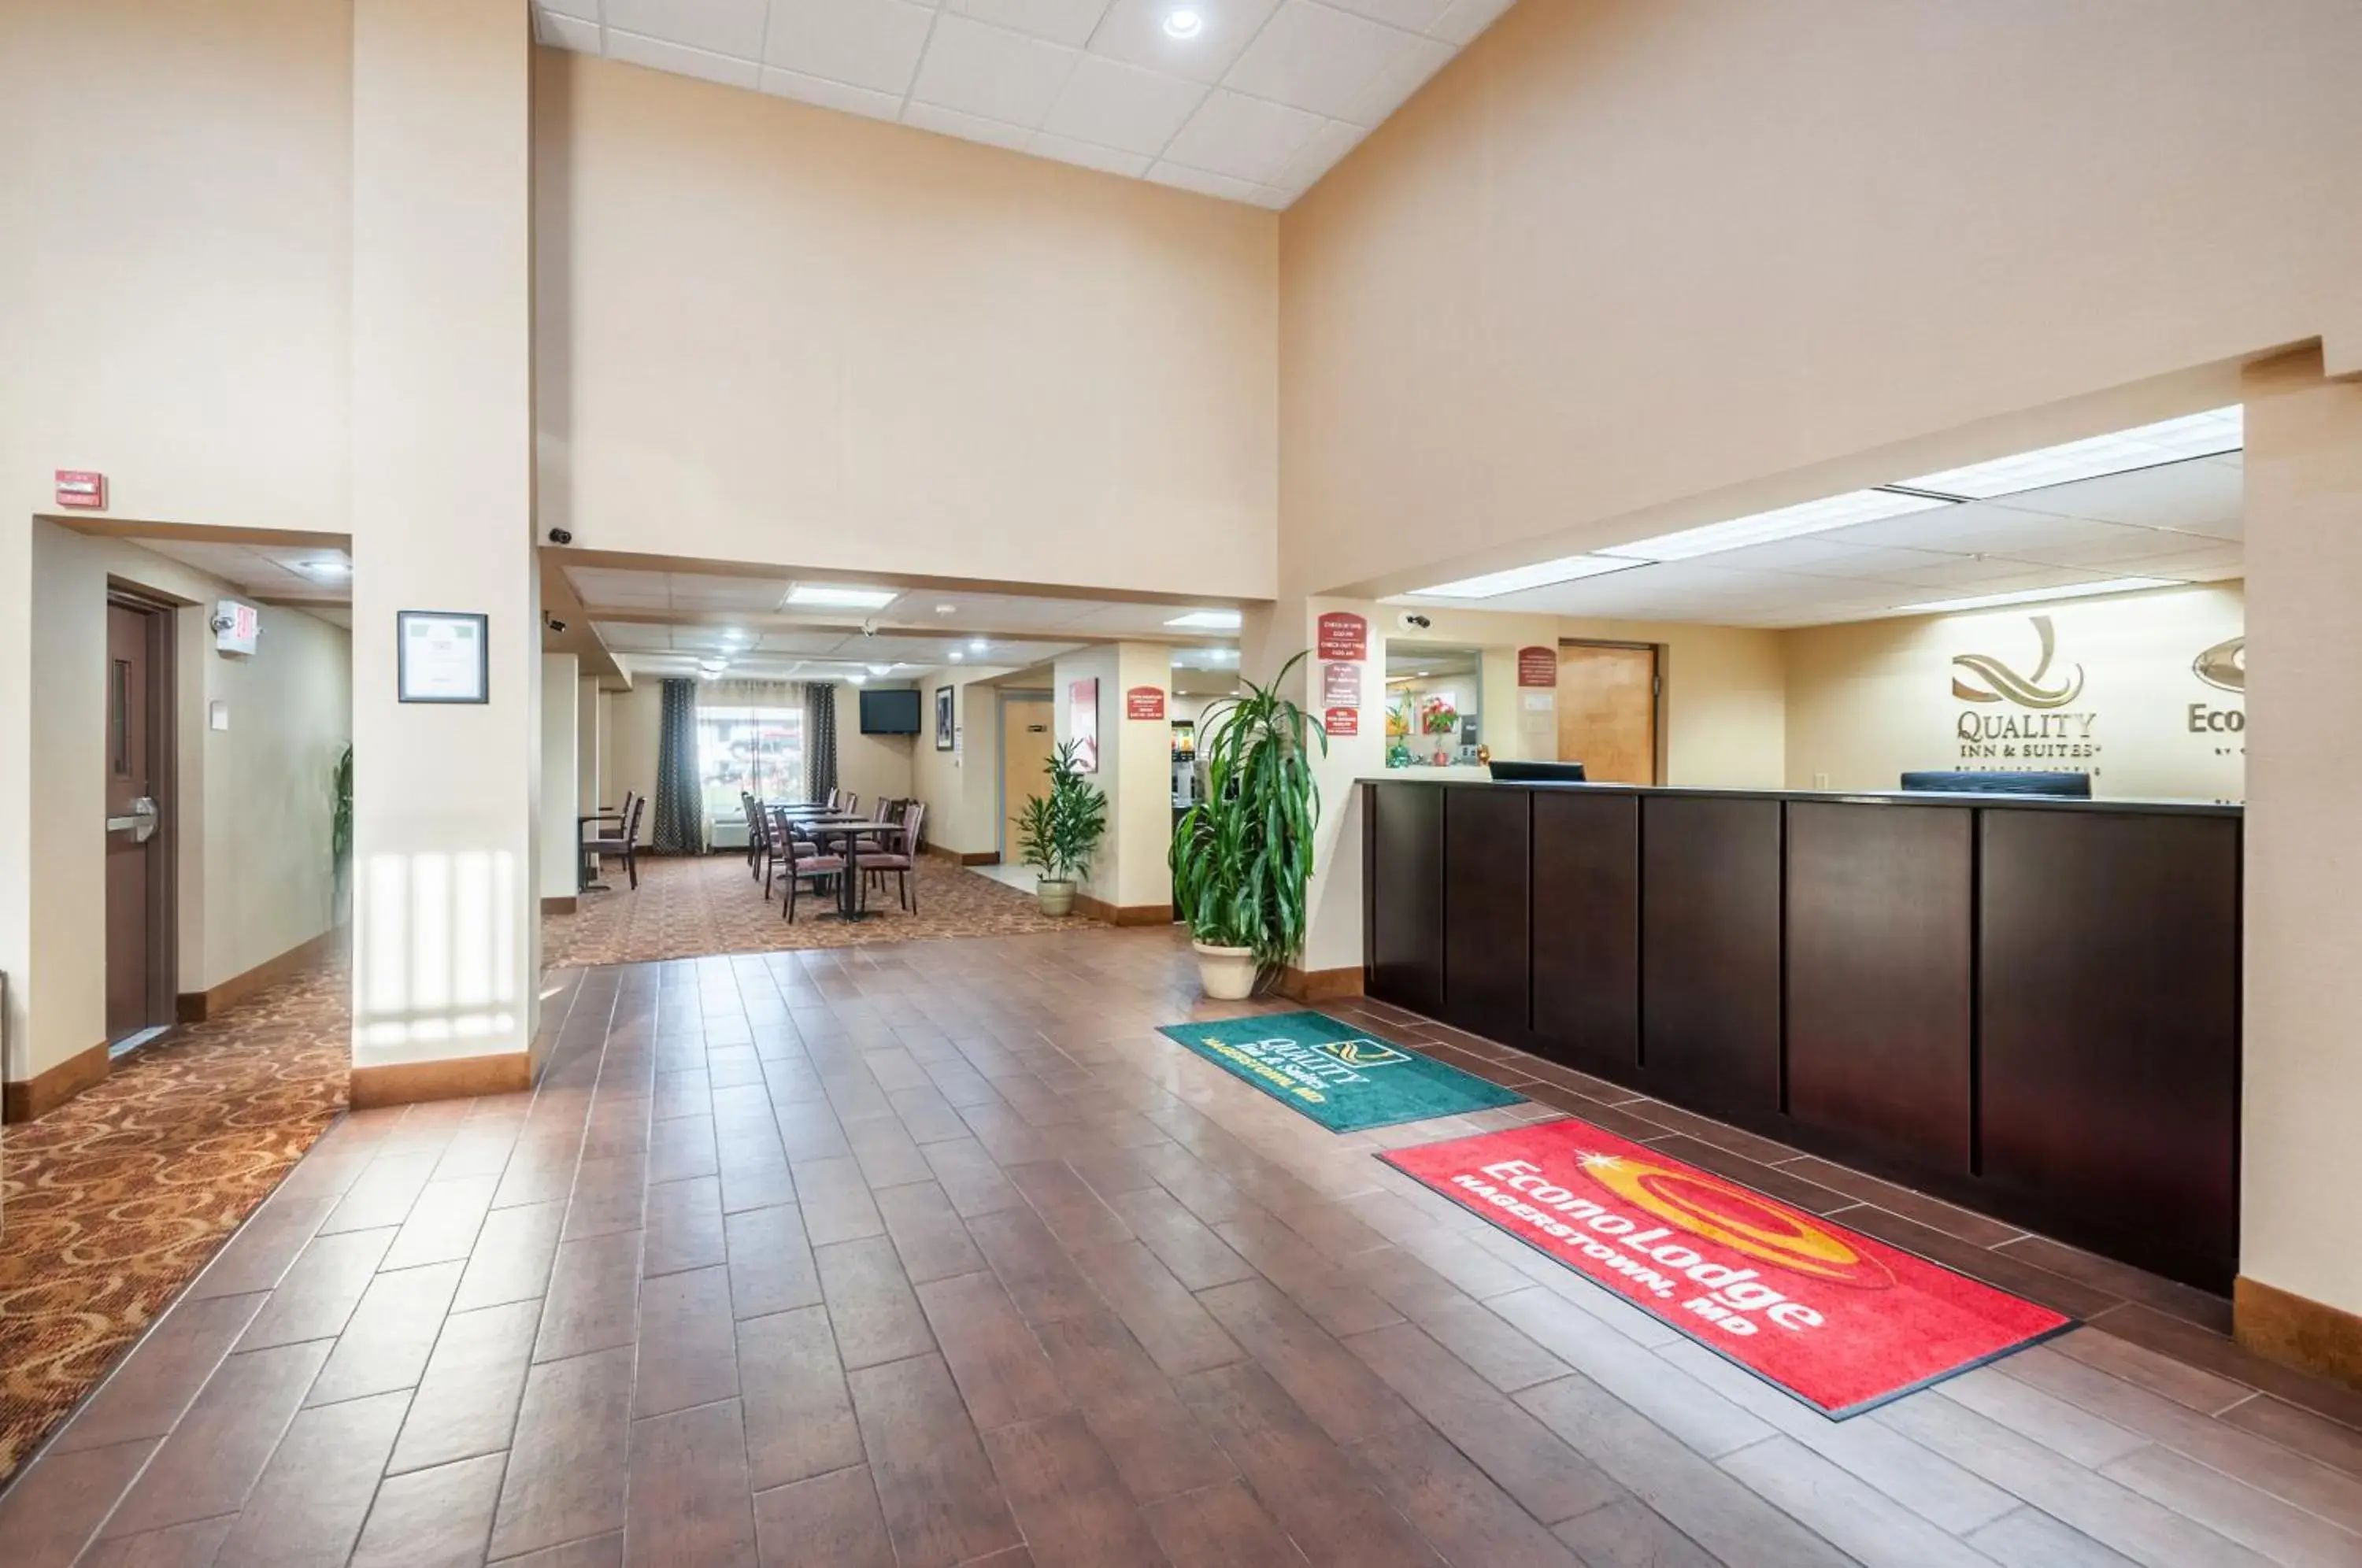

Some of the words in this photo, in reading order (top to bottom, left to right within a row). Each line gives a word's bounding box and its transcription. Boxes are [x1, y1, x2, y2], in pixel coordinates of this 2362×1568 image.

[1957, 711, 2097, 743] QUALITY
[1960, 745, 1997, 757] INN
[2003, 745, 2016, 757] &
[1258, 1038, 1370, 1083] QUALITY
[1451, 1174, 1677, 1299] HAGERSTOWN,
[1682, 1296, 1760, 1337] MD
